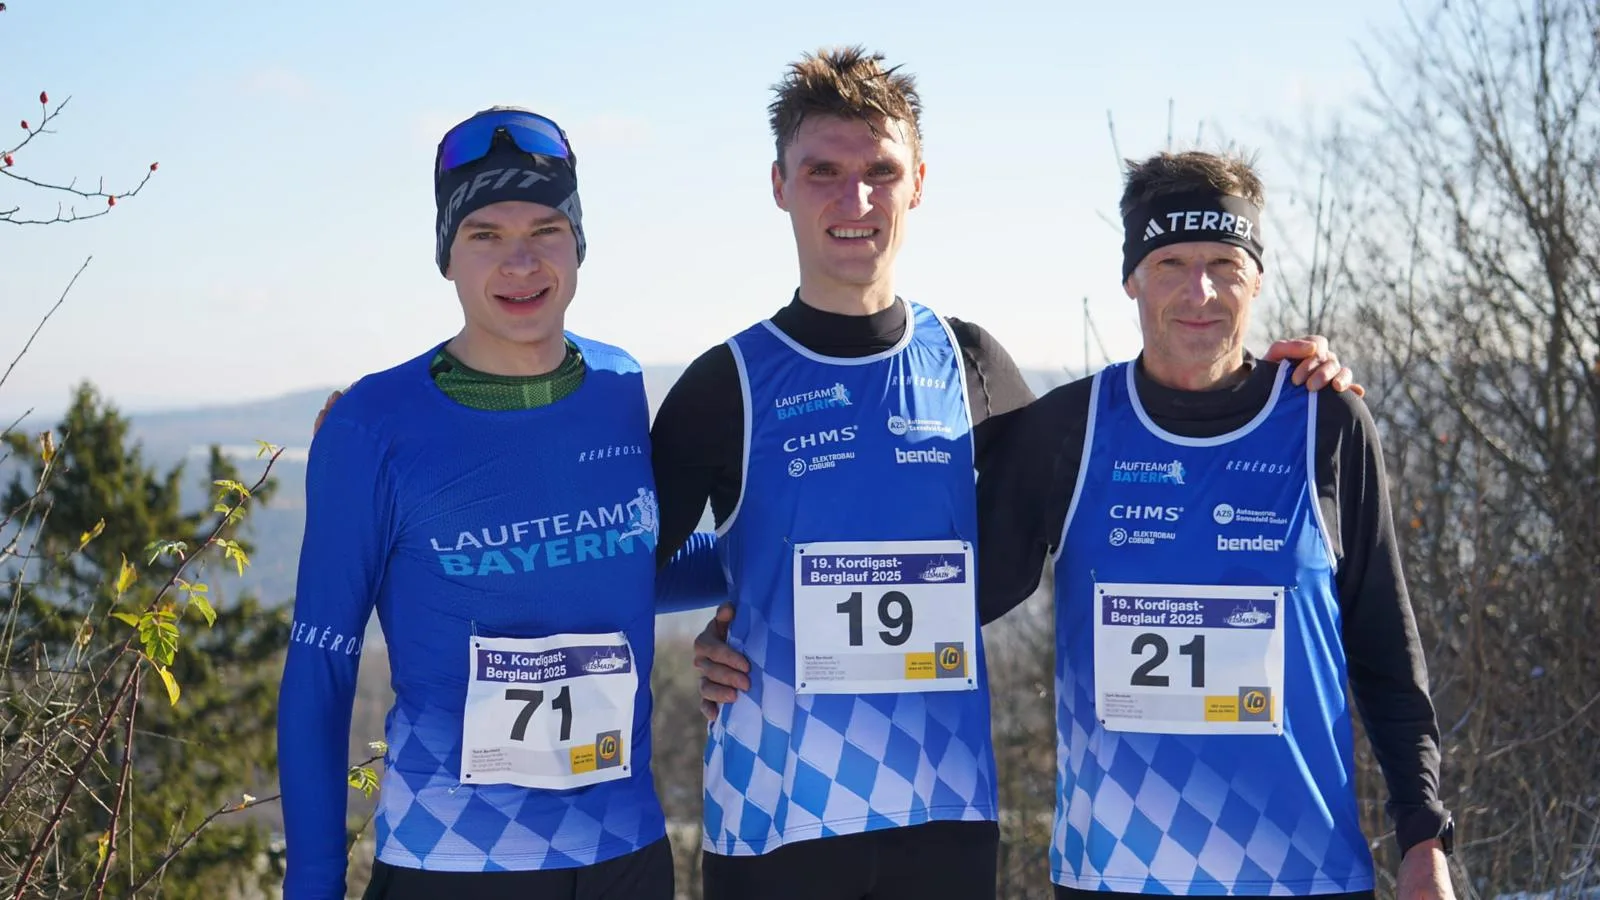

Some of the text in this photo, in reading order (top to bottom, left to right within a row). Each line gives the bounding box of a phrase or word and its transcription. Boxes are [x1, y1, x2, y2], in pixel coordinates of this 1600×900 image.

[1167, 211, 1254, 240] TERREX
[775, 388, 831, 408] LAUFTEAM
[895, 446, 951, 464] bender
[1114, 460, 1167, 472] LAUFTEAM
[430, 503, 624, 551] LAUFTEAM
[1217, 534, 1284, 551] bender
[439, 529, 634, 576] BAYERN
[811, 557, 902, 571] 19. Kordigast-
[811, 570, 901, 584] Berglauf 2025
[1111, 598, 1204, 612] 19. Kordigast-
[836, 591, 913, 646] 19
[1111, 612, 1203, 625] Berglauf 2025
[291, 620, 361, 656] ENÉRO
[486, 651, 567, 668] 19. Kordigast-
[1130, 633, 1205, 688] 21
[486, 665, 566, 682] Berglauf 2025
[505, 685, 572, 741] 71
